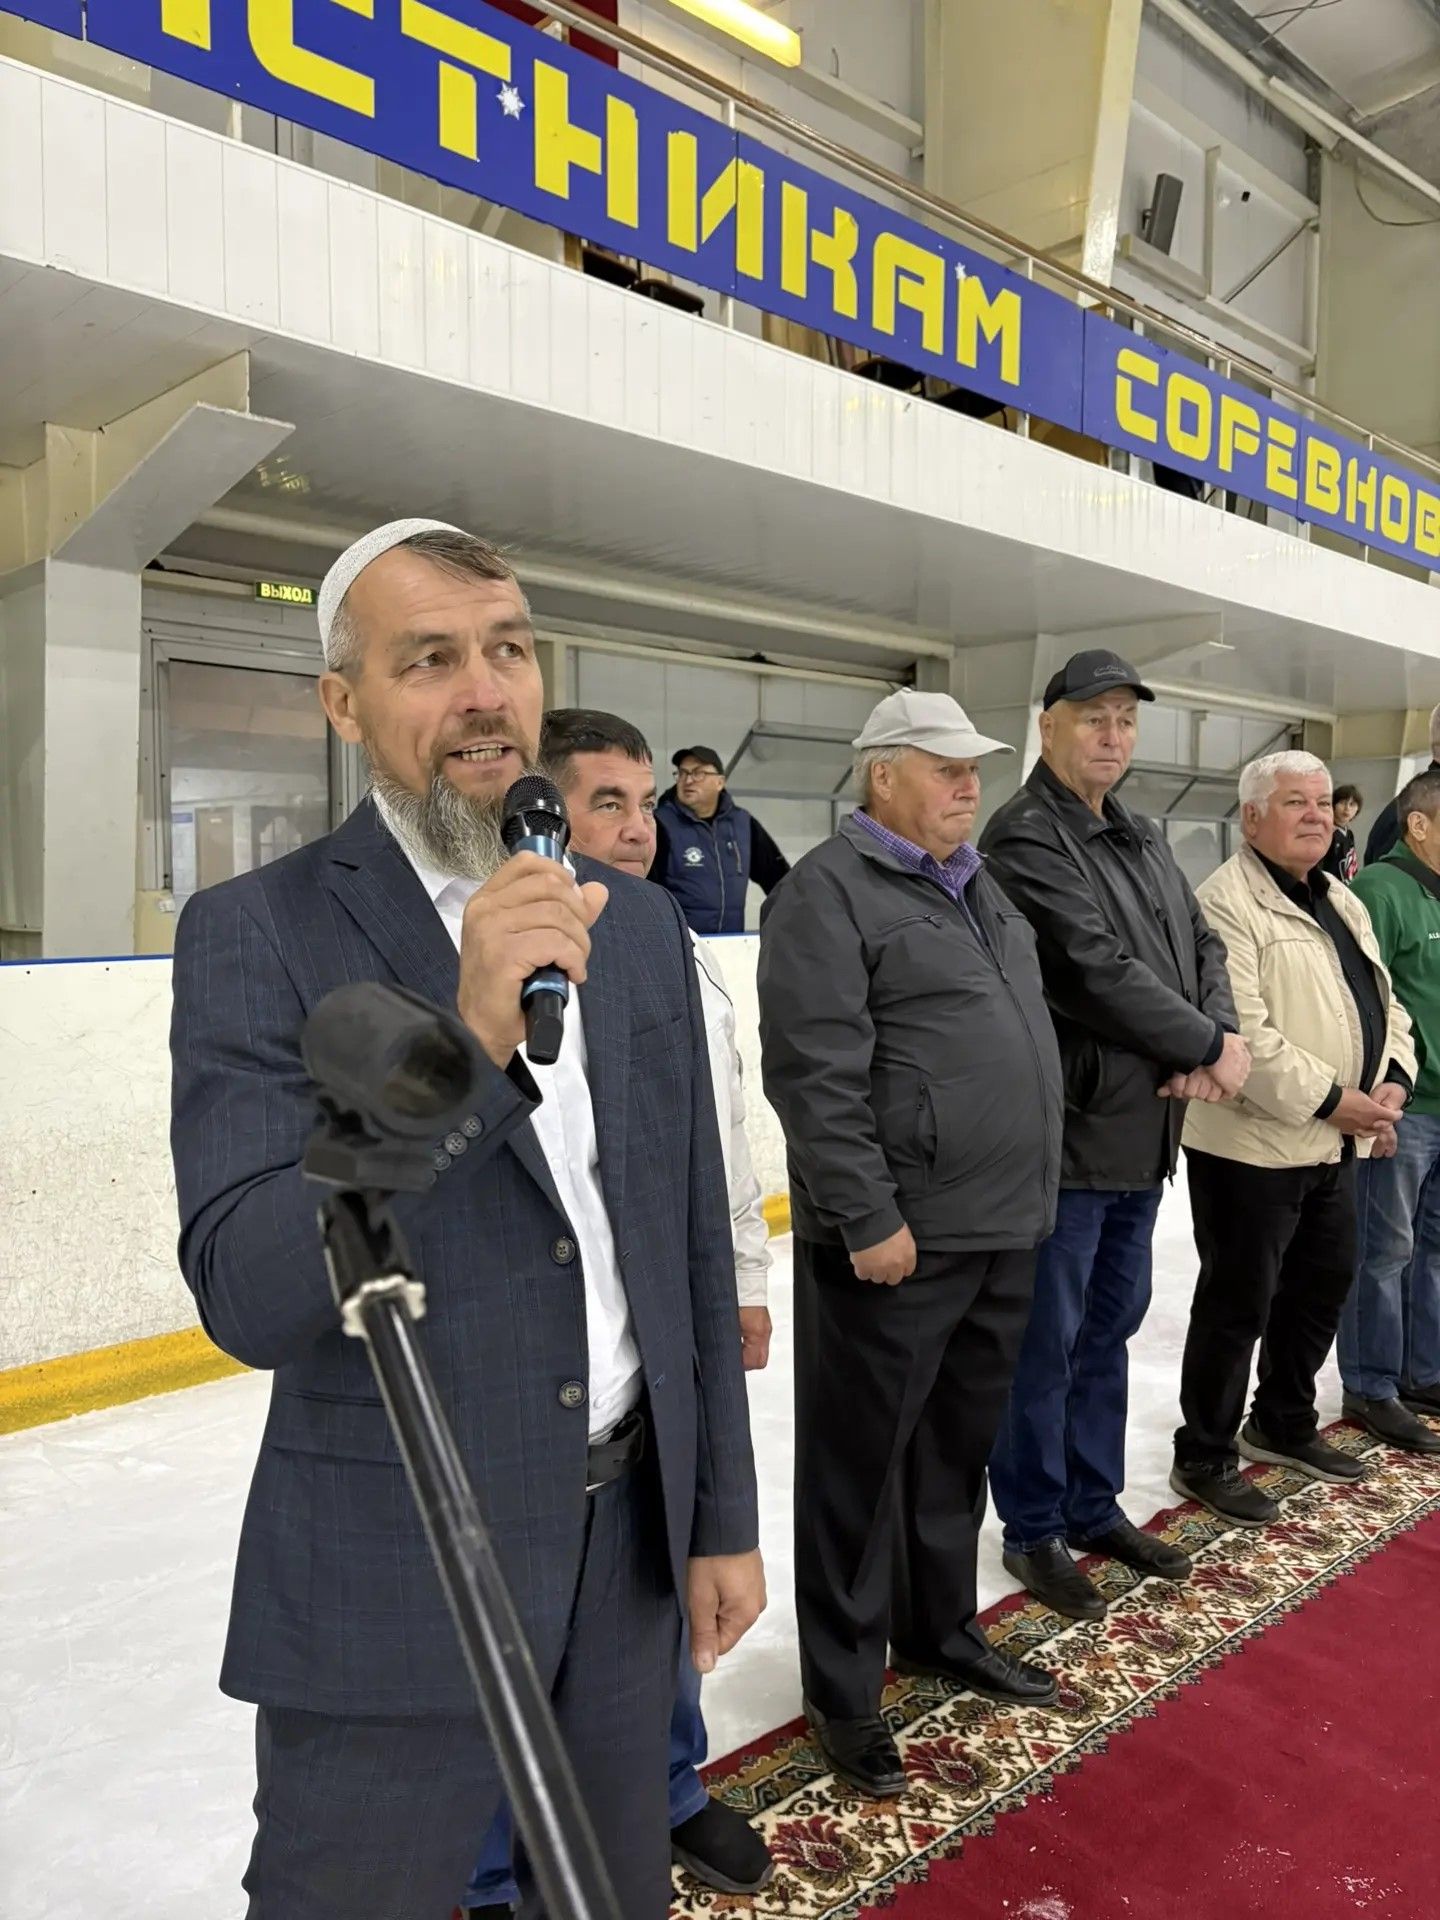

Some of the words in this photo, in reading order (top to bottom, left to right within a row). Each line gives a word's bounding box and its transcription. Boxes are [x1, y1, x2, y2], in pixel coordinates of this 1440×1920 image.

[161, 0, 1021, 386] СТНИКАМ
[1115, 348, 1440, 557] СОРЕВНОВ
[261, 583, 312, 603] ВЫХОД
